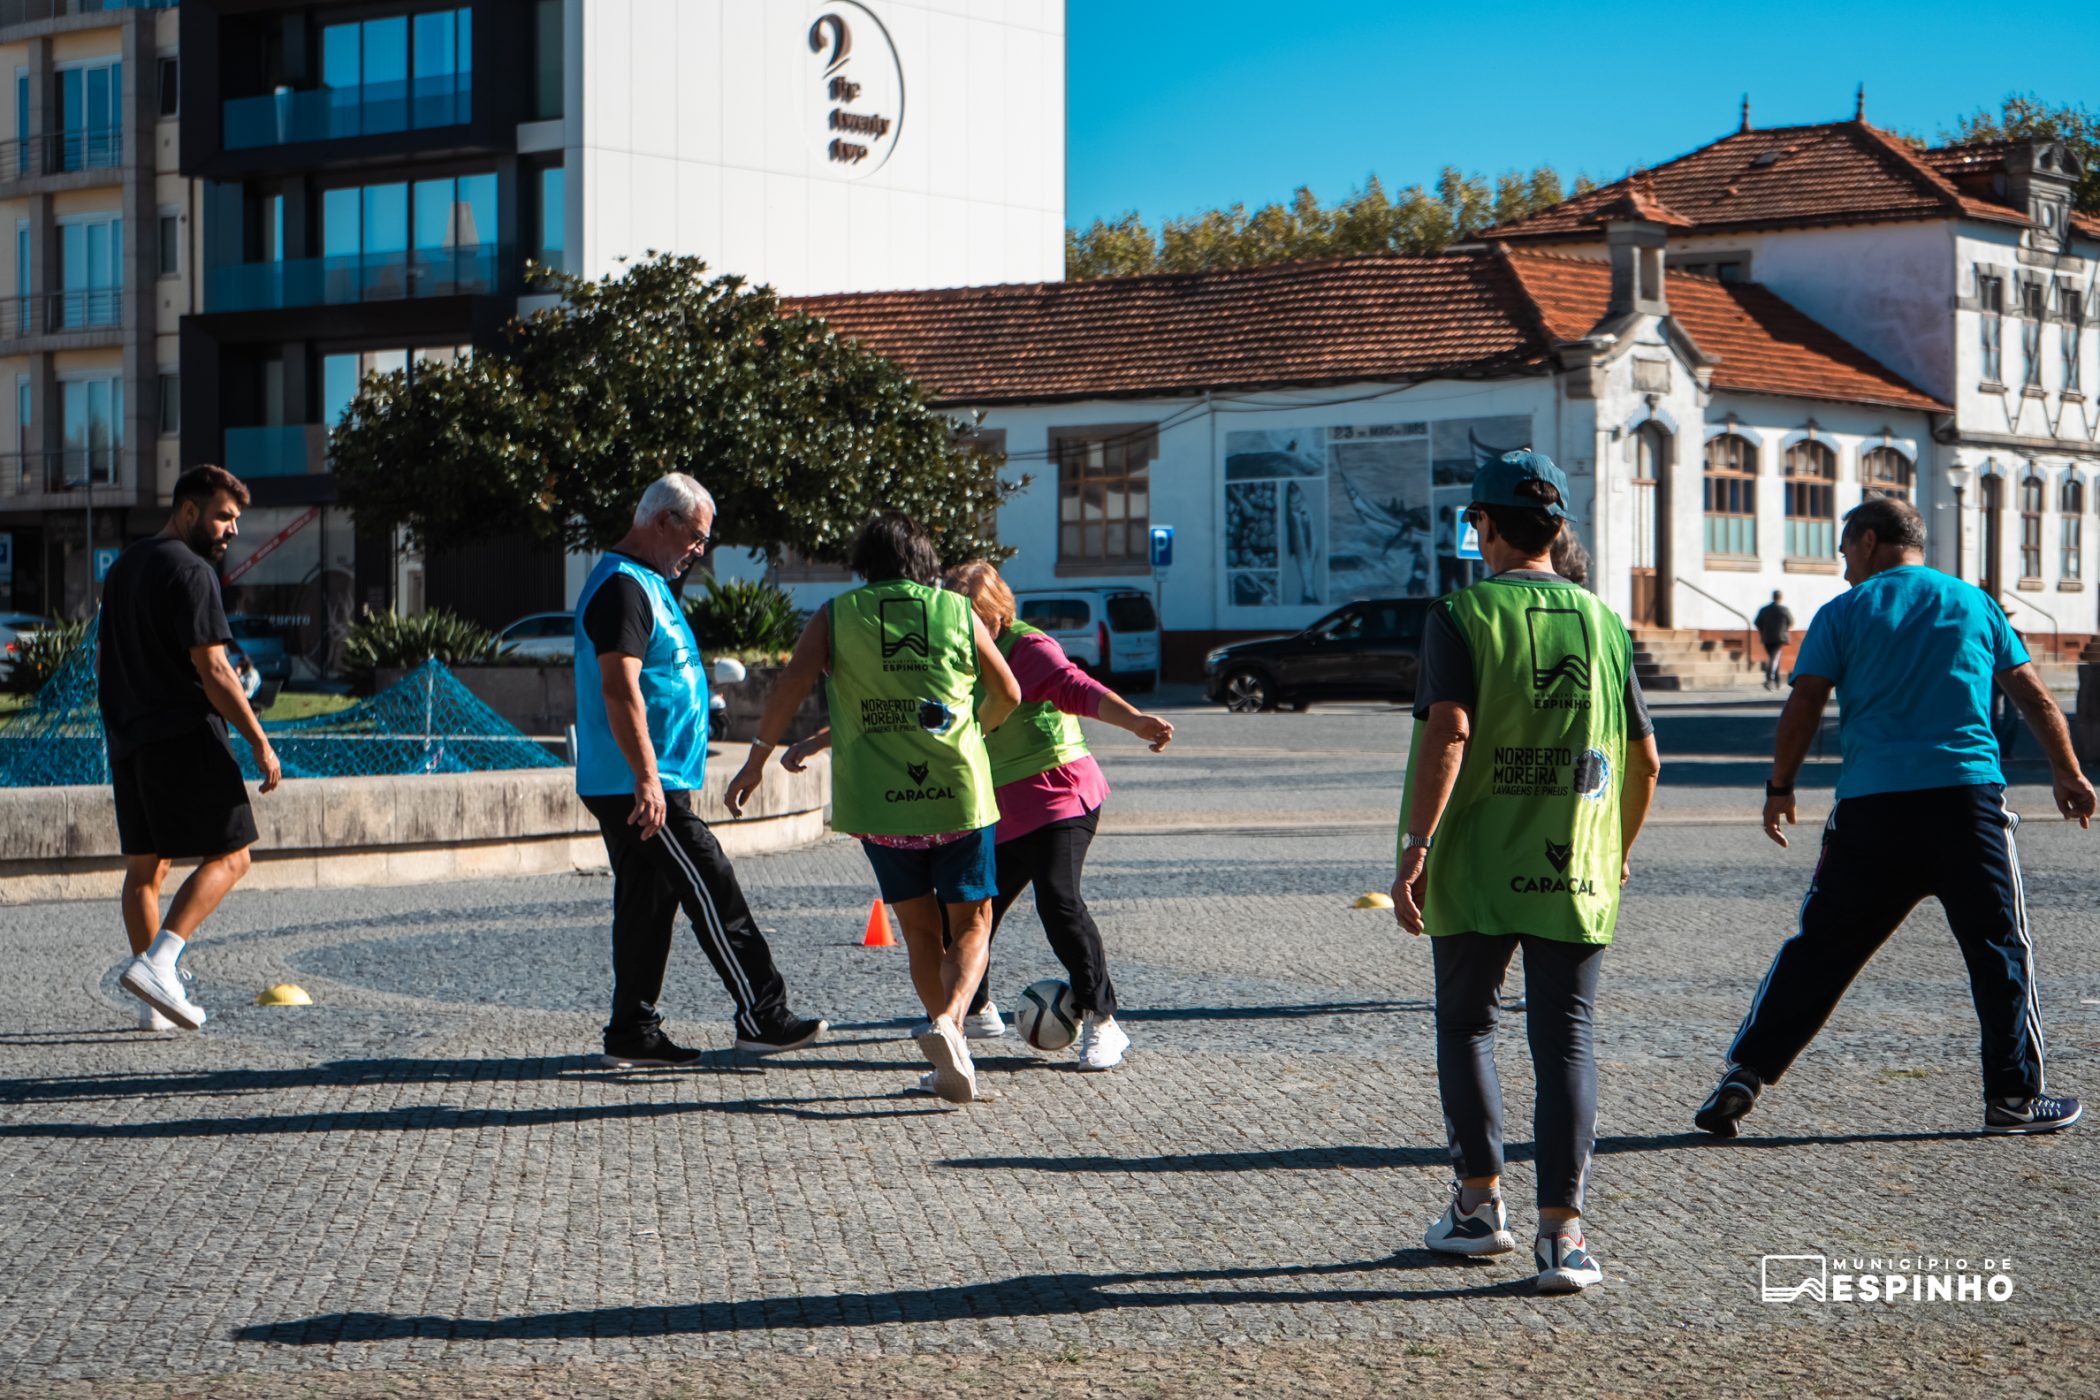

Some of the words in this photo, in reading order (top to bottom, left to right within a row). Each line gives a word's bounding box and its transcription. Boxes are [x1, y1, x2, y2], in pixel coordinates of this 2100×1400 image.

[1154, 530, 1168, 563] P
[98, 552, 113, 578] P
[882, 664, 929, 672] ESPINHO
[861, 698, 917, 712] NORBERTO
[1534, 699, 1592, 709] ESPINHO
[862, 711, 909, 725] MOREIRA
[1494, 747, 1572, 766] NORBERTO
[1493, 767, 1558, 785] MOREIRA
[884, 786, 956, 803] CARACAL
[1492, 785, 1533, 796] LAVAGENS
[1534, 786, 1540, 796] E
[1542, 786, 1569, 796] PNEUS
[1510, 876, 1596, 897] CARACAL
